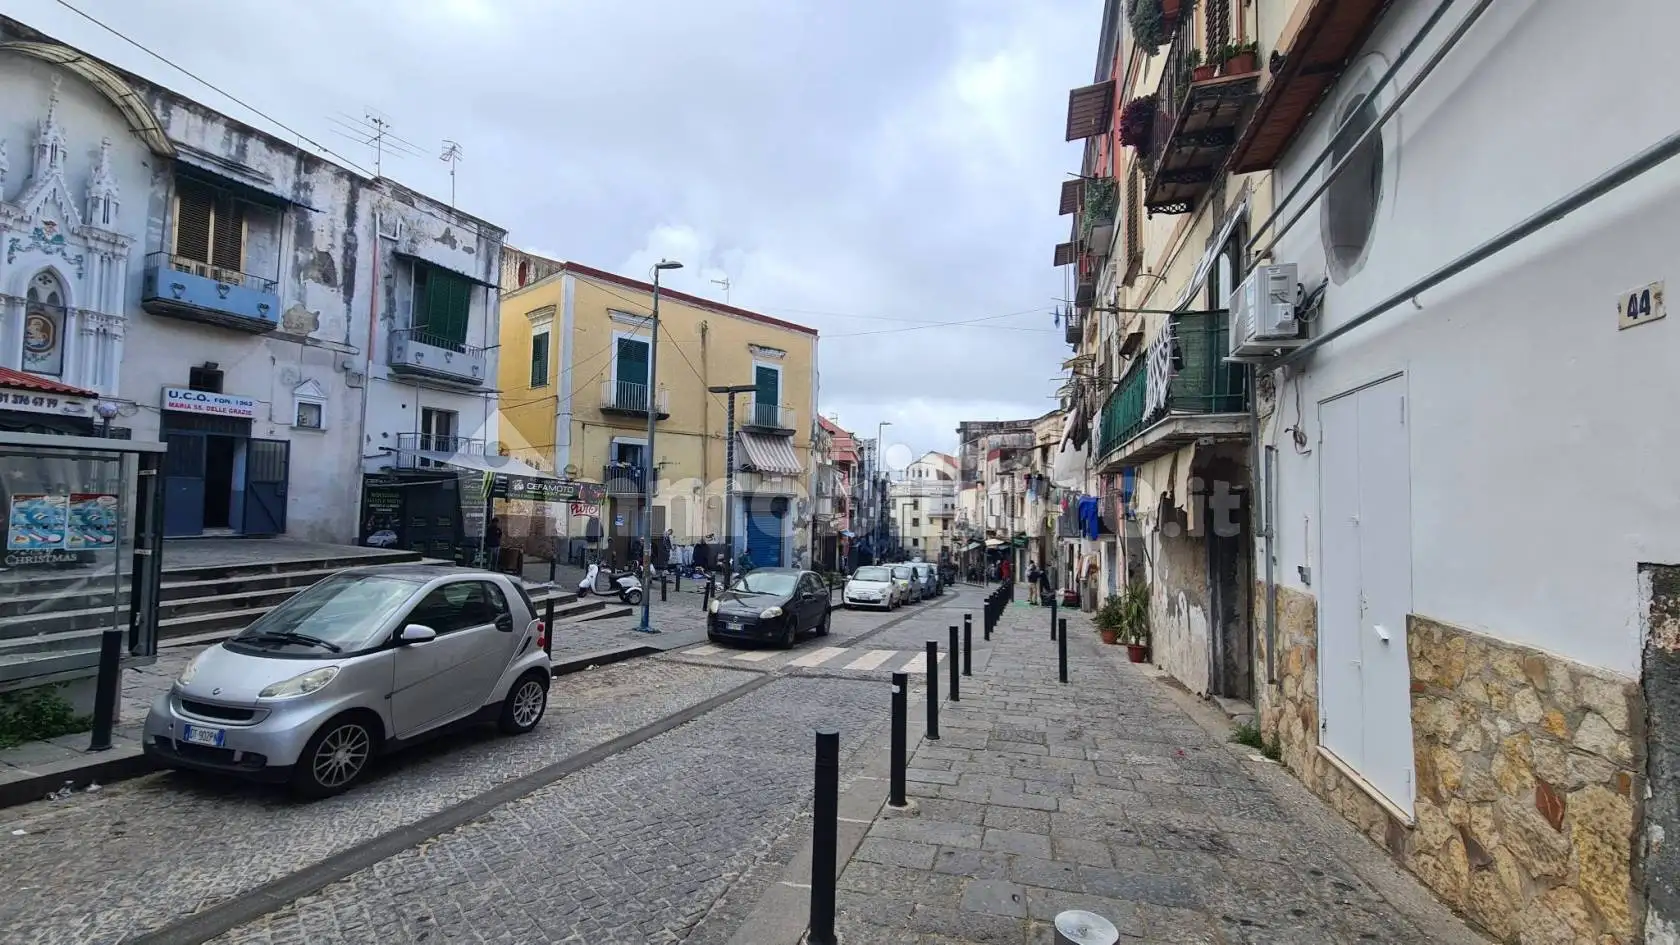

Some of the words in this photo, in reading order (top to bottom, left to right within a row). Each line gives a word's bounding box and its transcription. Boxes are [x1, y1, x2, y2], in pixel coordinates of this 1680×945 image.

[1627, 289, 1651, 320] 44
[168, 401, 191, 409] MARIA
[206, 405, 227, 414] DELLE
[228, 407, 252, 416] GRAZIE
[526, 482, 574, 493] CEFAMOTO
[5, 553, 77, 566] CHRISTMAS
